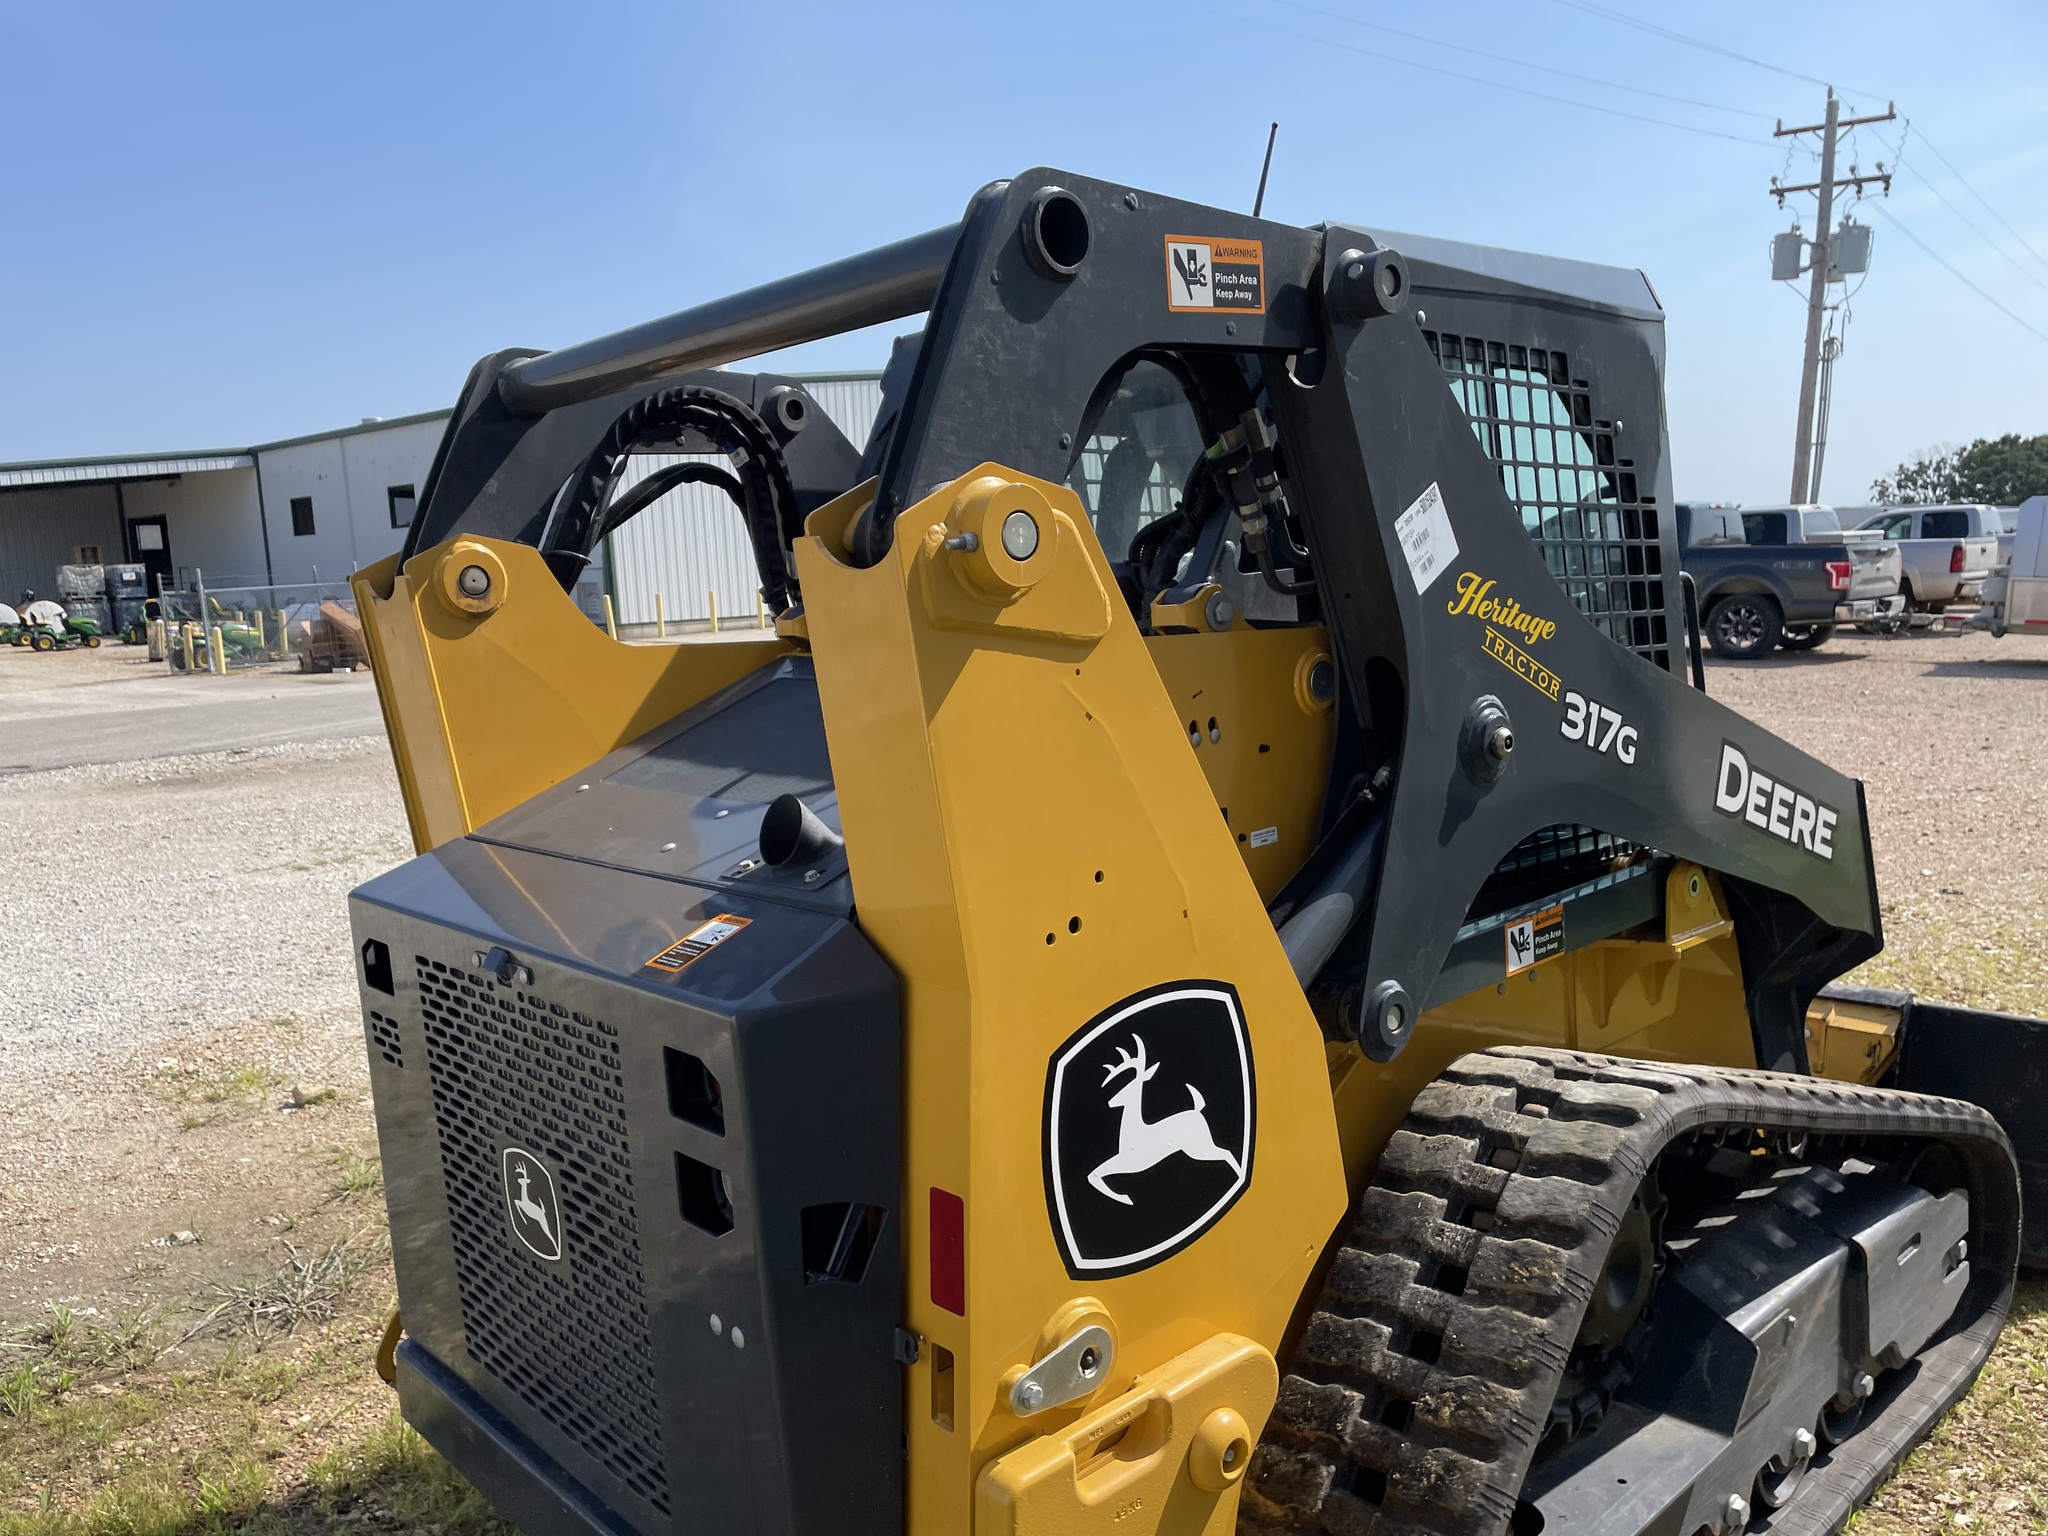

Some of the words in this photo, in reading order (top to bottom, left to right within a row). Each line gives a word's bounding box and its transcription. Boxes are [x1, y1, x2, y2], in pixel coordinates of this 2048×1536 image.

[1215, 273, 1238, 284] Pinch
[1239, 274, 1257, 285] Area
[1223, 248, 1257, 258] WARNING
[1216, 289, 1233, 300] Keep
[1234, 290, 1252, 301] Away
[1447, 571, 1556, 645] Heritage
[1485, 628, 1560, 697] TRACTOR
[1561, 692, 1638, 764] 317G
[1716, 744, 1838, 860] DEERE
